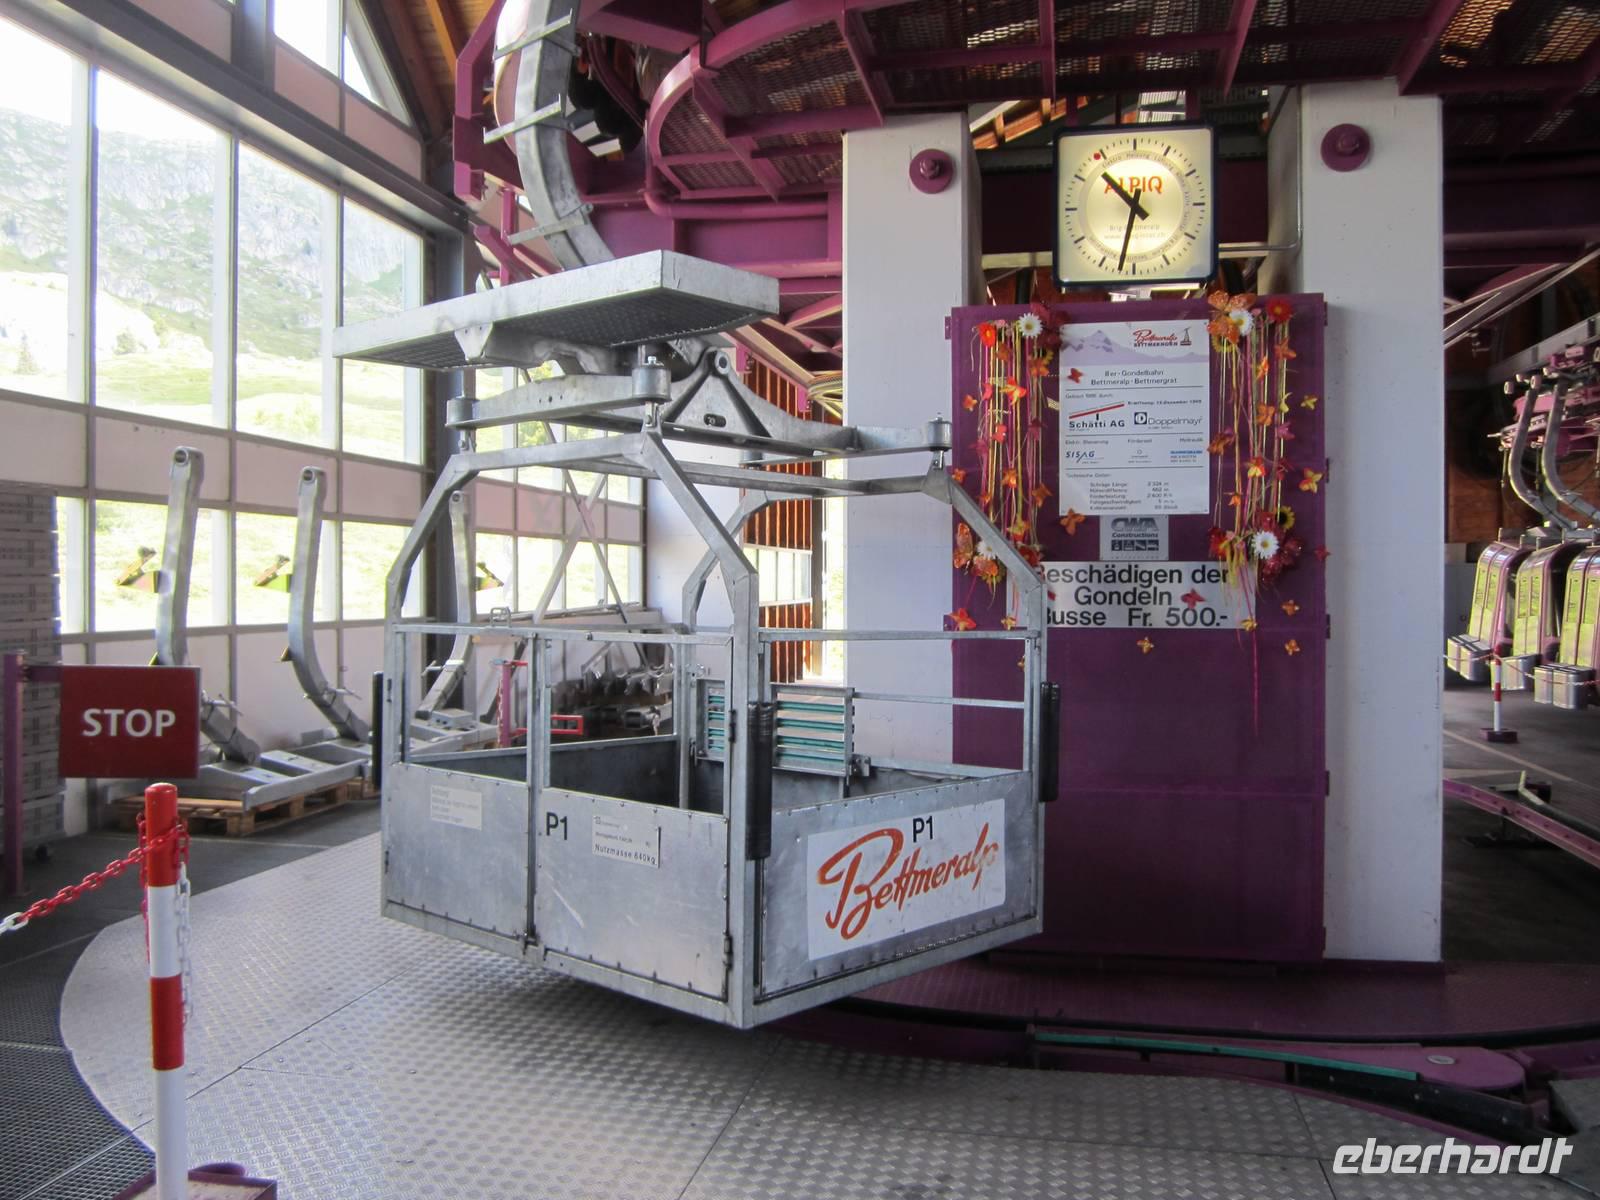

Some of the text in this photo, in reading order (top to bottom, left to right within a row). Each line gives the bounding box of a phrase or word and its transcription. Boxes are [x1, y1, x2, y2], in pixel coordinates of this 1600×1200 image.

[1091, 377, 1177, 386] Bettmeralp Bettmergrat
[1121, 369, 1164, 377] Gondelbahn
[1109, 419, 1125, 428] AG
[1148, 416, 1203, 426] Doppelmayr
[1191, 564, 1229, 584] der
[1074, 586, 1172, 606] Gondeln
[1128, 607, 1152, 626] Fr.
[1165, 607, 1228, 627] 500.-
[82, 708, 176, 737] STOP
[546, 812, 568, 840] P1
[912, 816, 934, 843] P1
[595, 843, 632, 859] Nutzmasse
[816, 822, 999, 940] Bettmeralp
